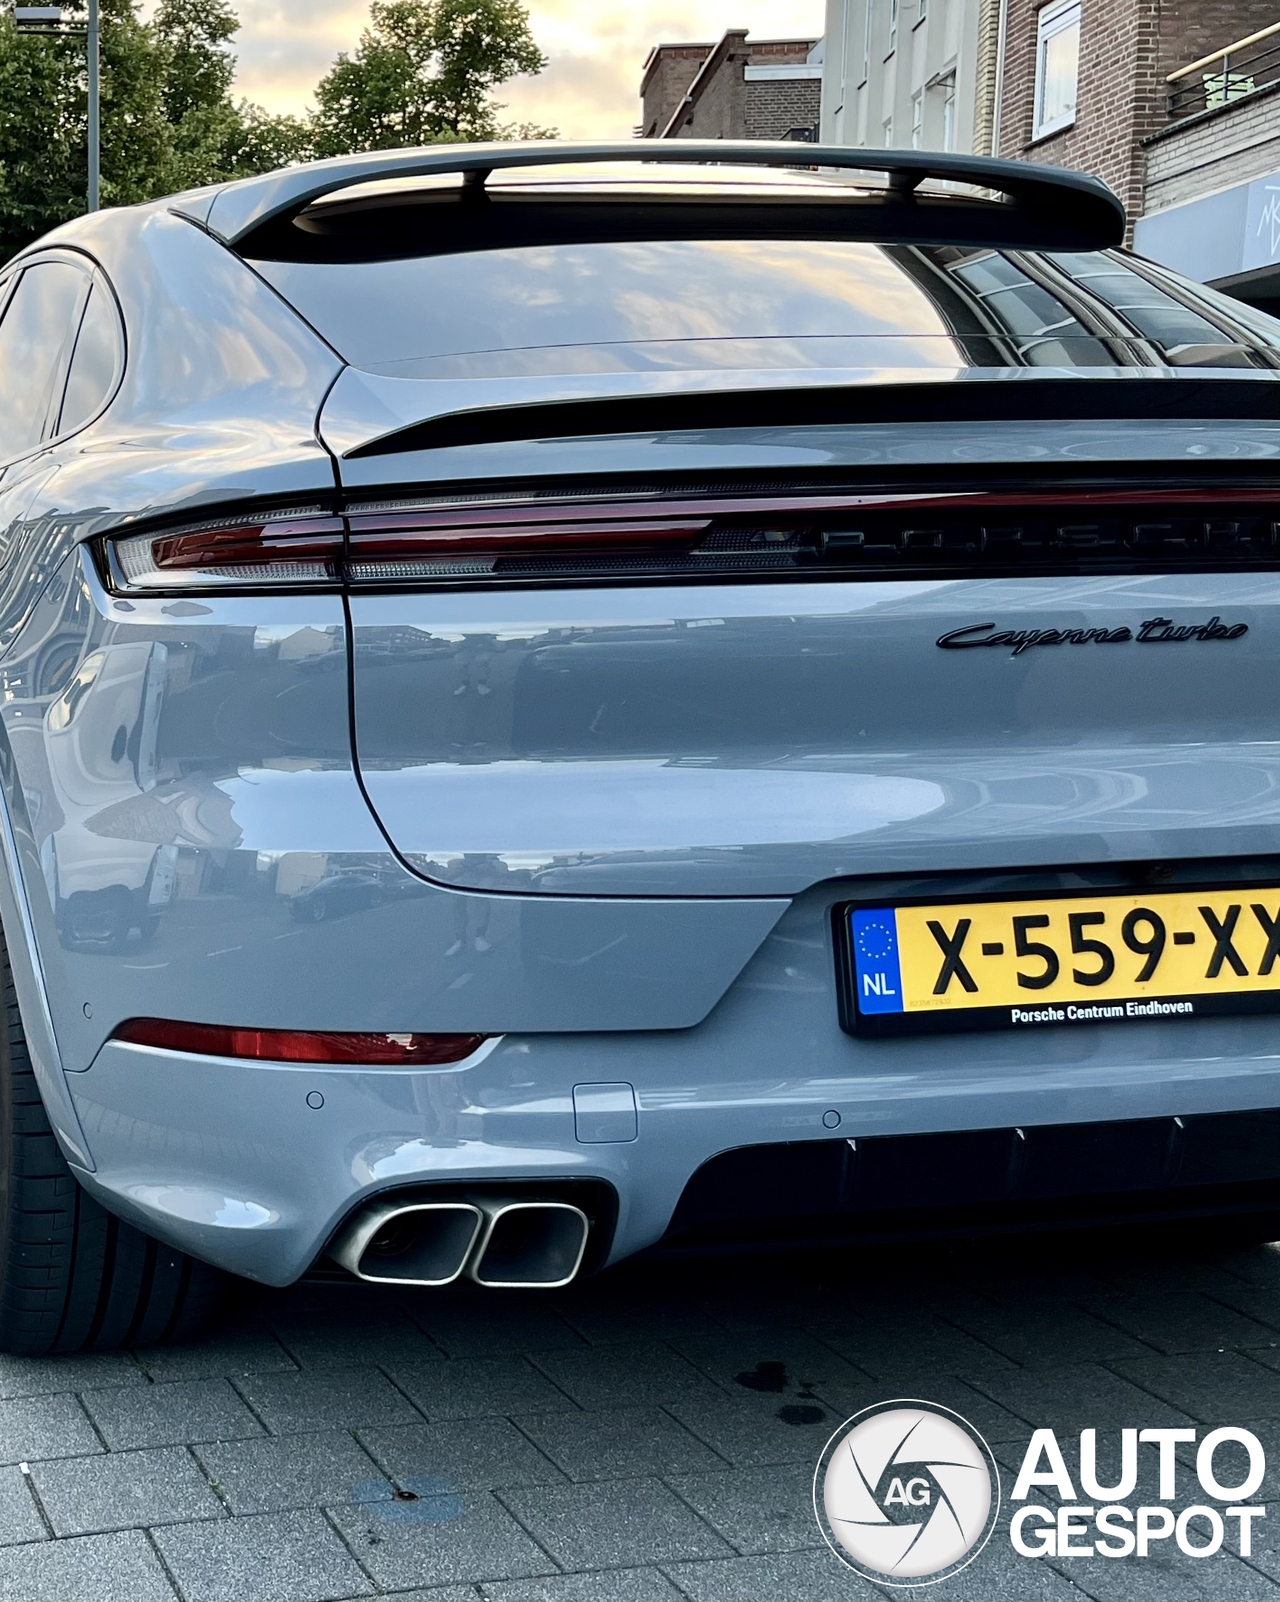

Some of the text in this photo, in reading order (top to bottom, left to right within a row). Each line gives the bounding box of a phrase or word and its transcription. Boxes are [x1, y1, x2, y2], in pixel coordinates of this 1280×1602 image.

[821, 522, 1280, 556] PORSCH
[935, 617, 1249, 655] Cayenne turbo
[926, 903, 1280, 995] X-559-XX
[863, 972, 896, 996] NL
[1011, 1001, 1193, 1023] Porsche Centrum Eindhoven
